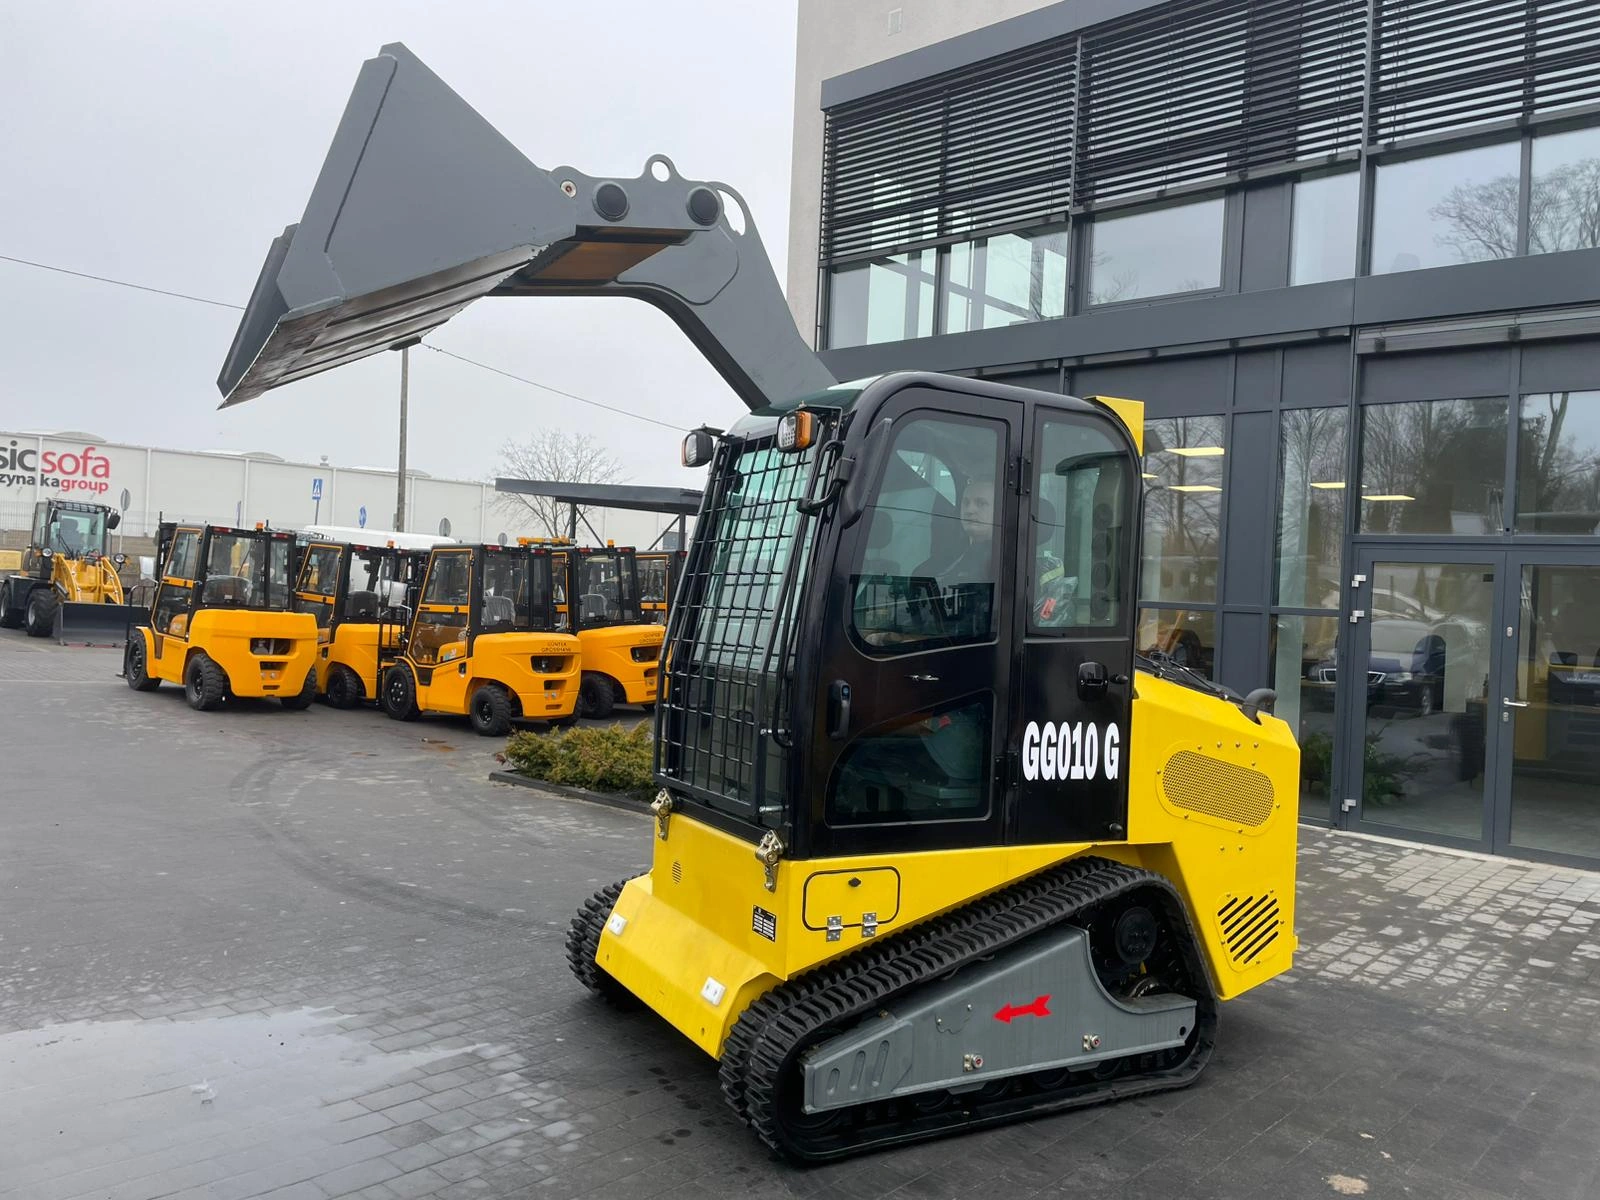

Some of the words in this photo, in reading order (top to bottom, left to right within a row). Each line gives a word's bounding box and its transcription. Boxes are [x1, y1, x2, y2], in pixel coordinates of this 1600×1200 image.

[41, 446, 110, 479] sofa
[1022, 721, 1099, 781] GG010
[1104, 722, 1120, 781] G
